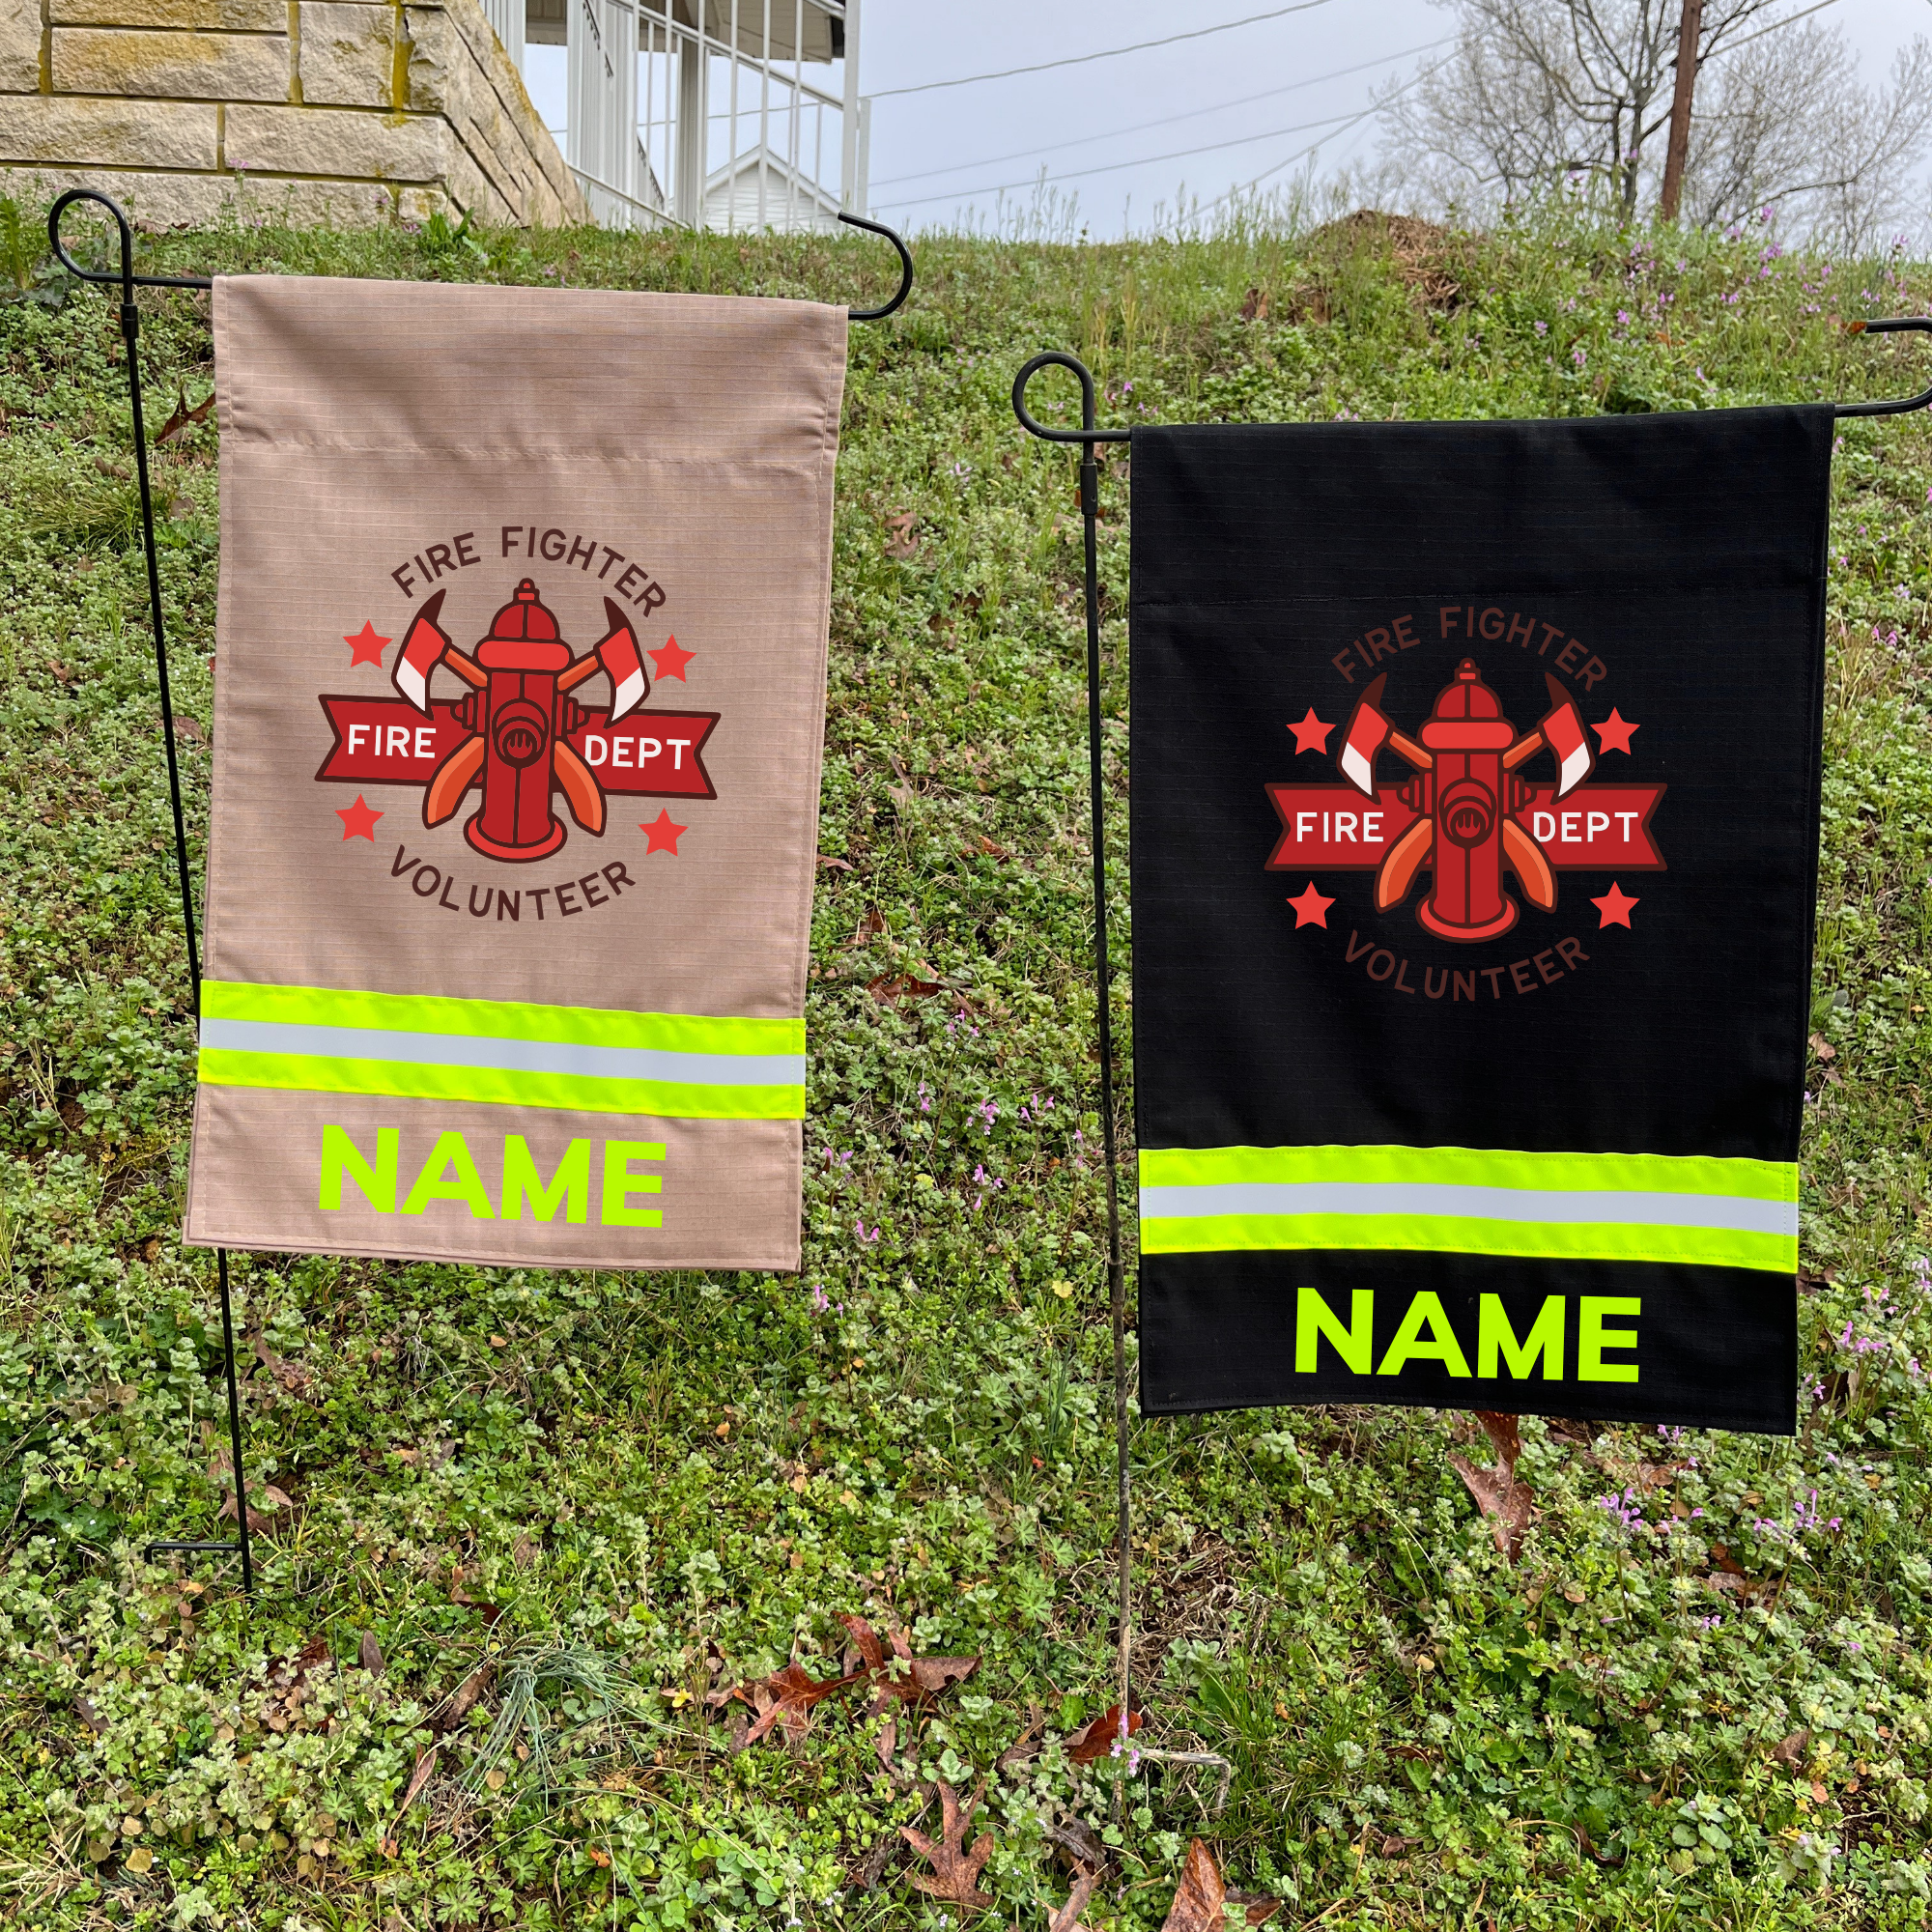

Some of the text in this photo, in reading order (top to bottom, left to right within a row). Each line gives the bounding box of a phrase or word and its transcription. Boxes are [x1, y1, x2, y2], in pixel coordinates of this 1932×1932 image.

[391, 526, 667, 617] FIRE FIGHTER
[1331, 606, 1607, 692] FIRE FIGHTER
[348, 724, 691, 770] FIRE DEPT
[1296, 811, 1638, 842] FIRE DEPT
[391, 844, 636, 922] VOLUNTEER
[1345, 929, 1590, 1001] VOLUNTEER
[319, 1124, 667, 1228] NAME
[1295, 1287, 1641, 1382] NAME
